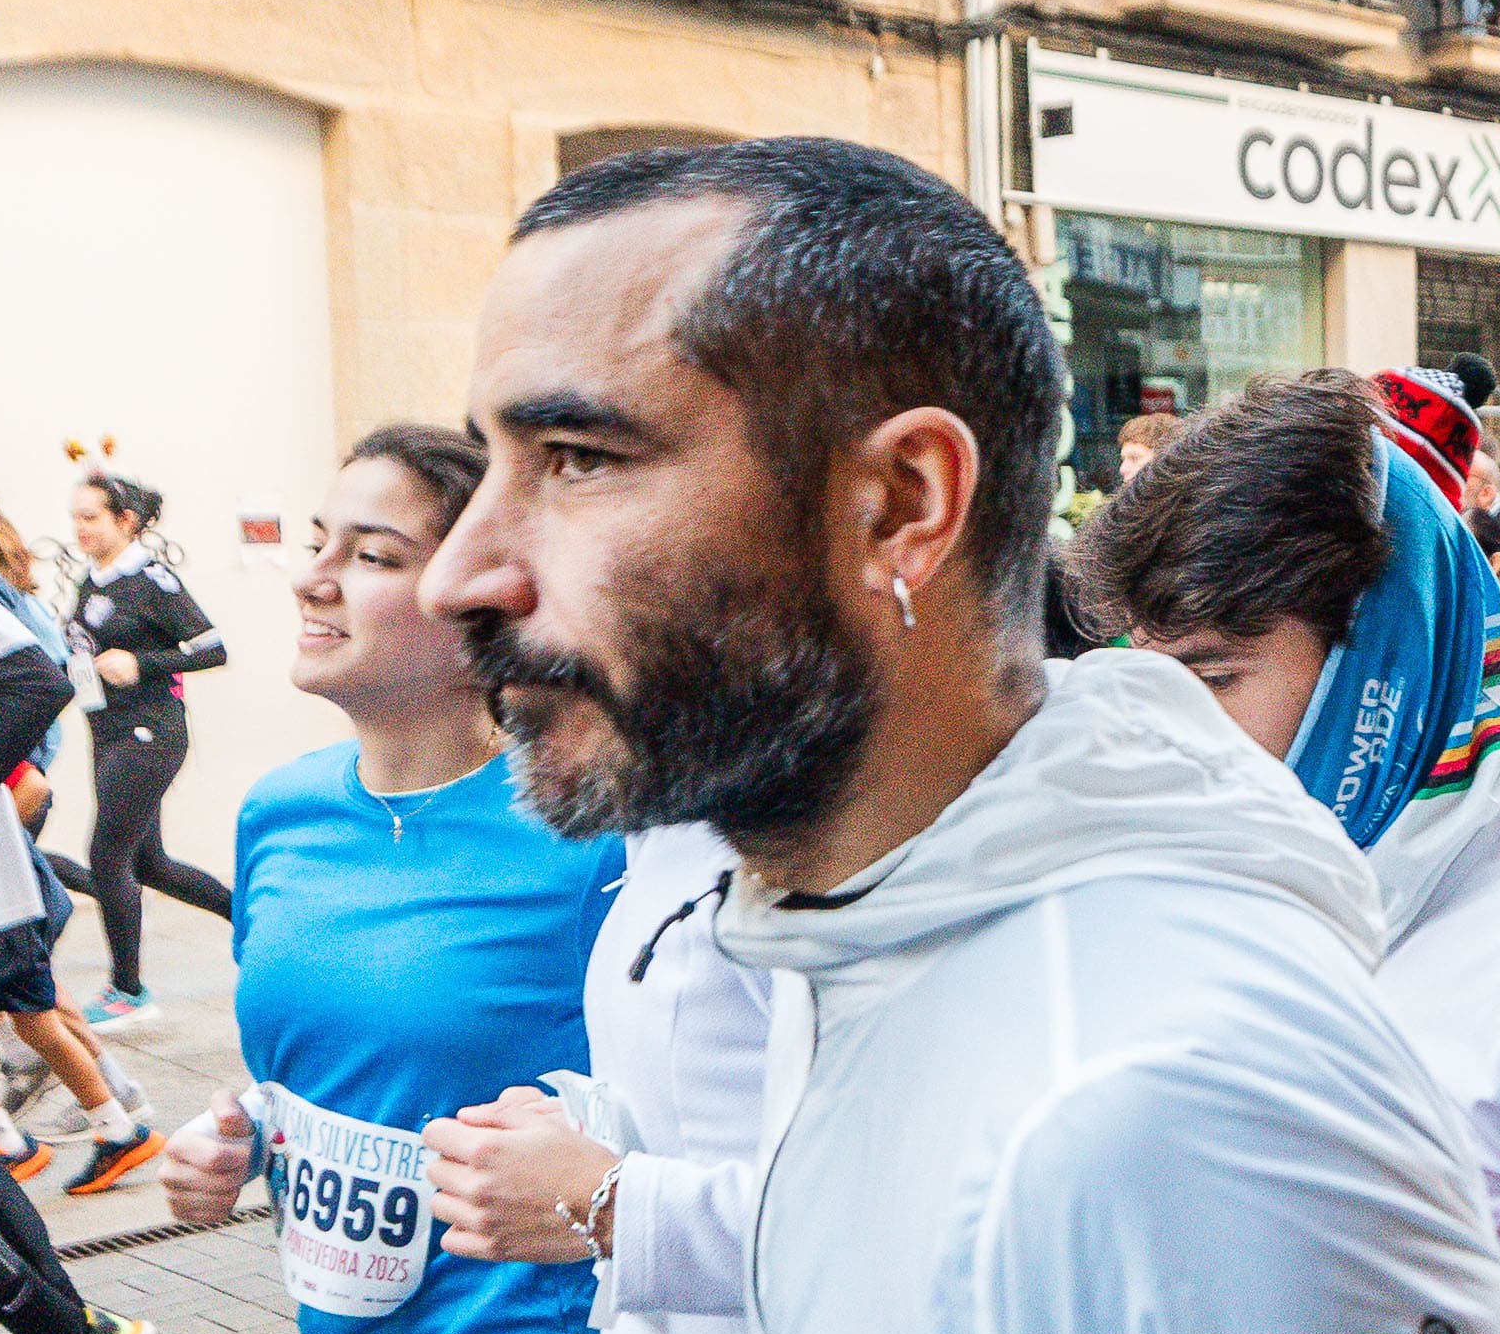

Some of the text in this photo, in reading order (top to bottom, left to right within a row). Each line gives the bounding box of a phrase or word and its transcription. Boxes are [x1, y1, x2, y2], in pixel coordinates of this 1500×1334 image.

[1237, 115, 1462, 221] codex
[1333, 678, 1381, 822] POWER
[316, 1120, 427, 1182] SILVESTRE
[293, 1157, 419, 1248] 6959
[364, 1255, 410, 1283] 2025
